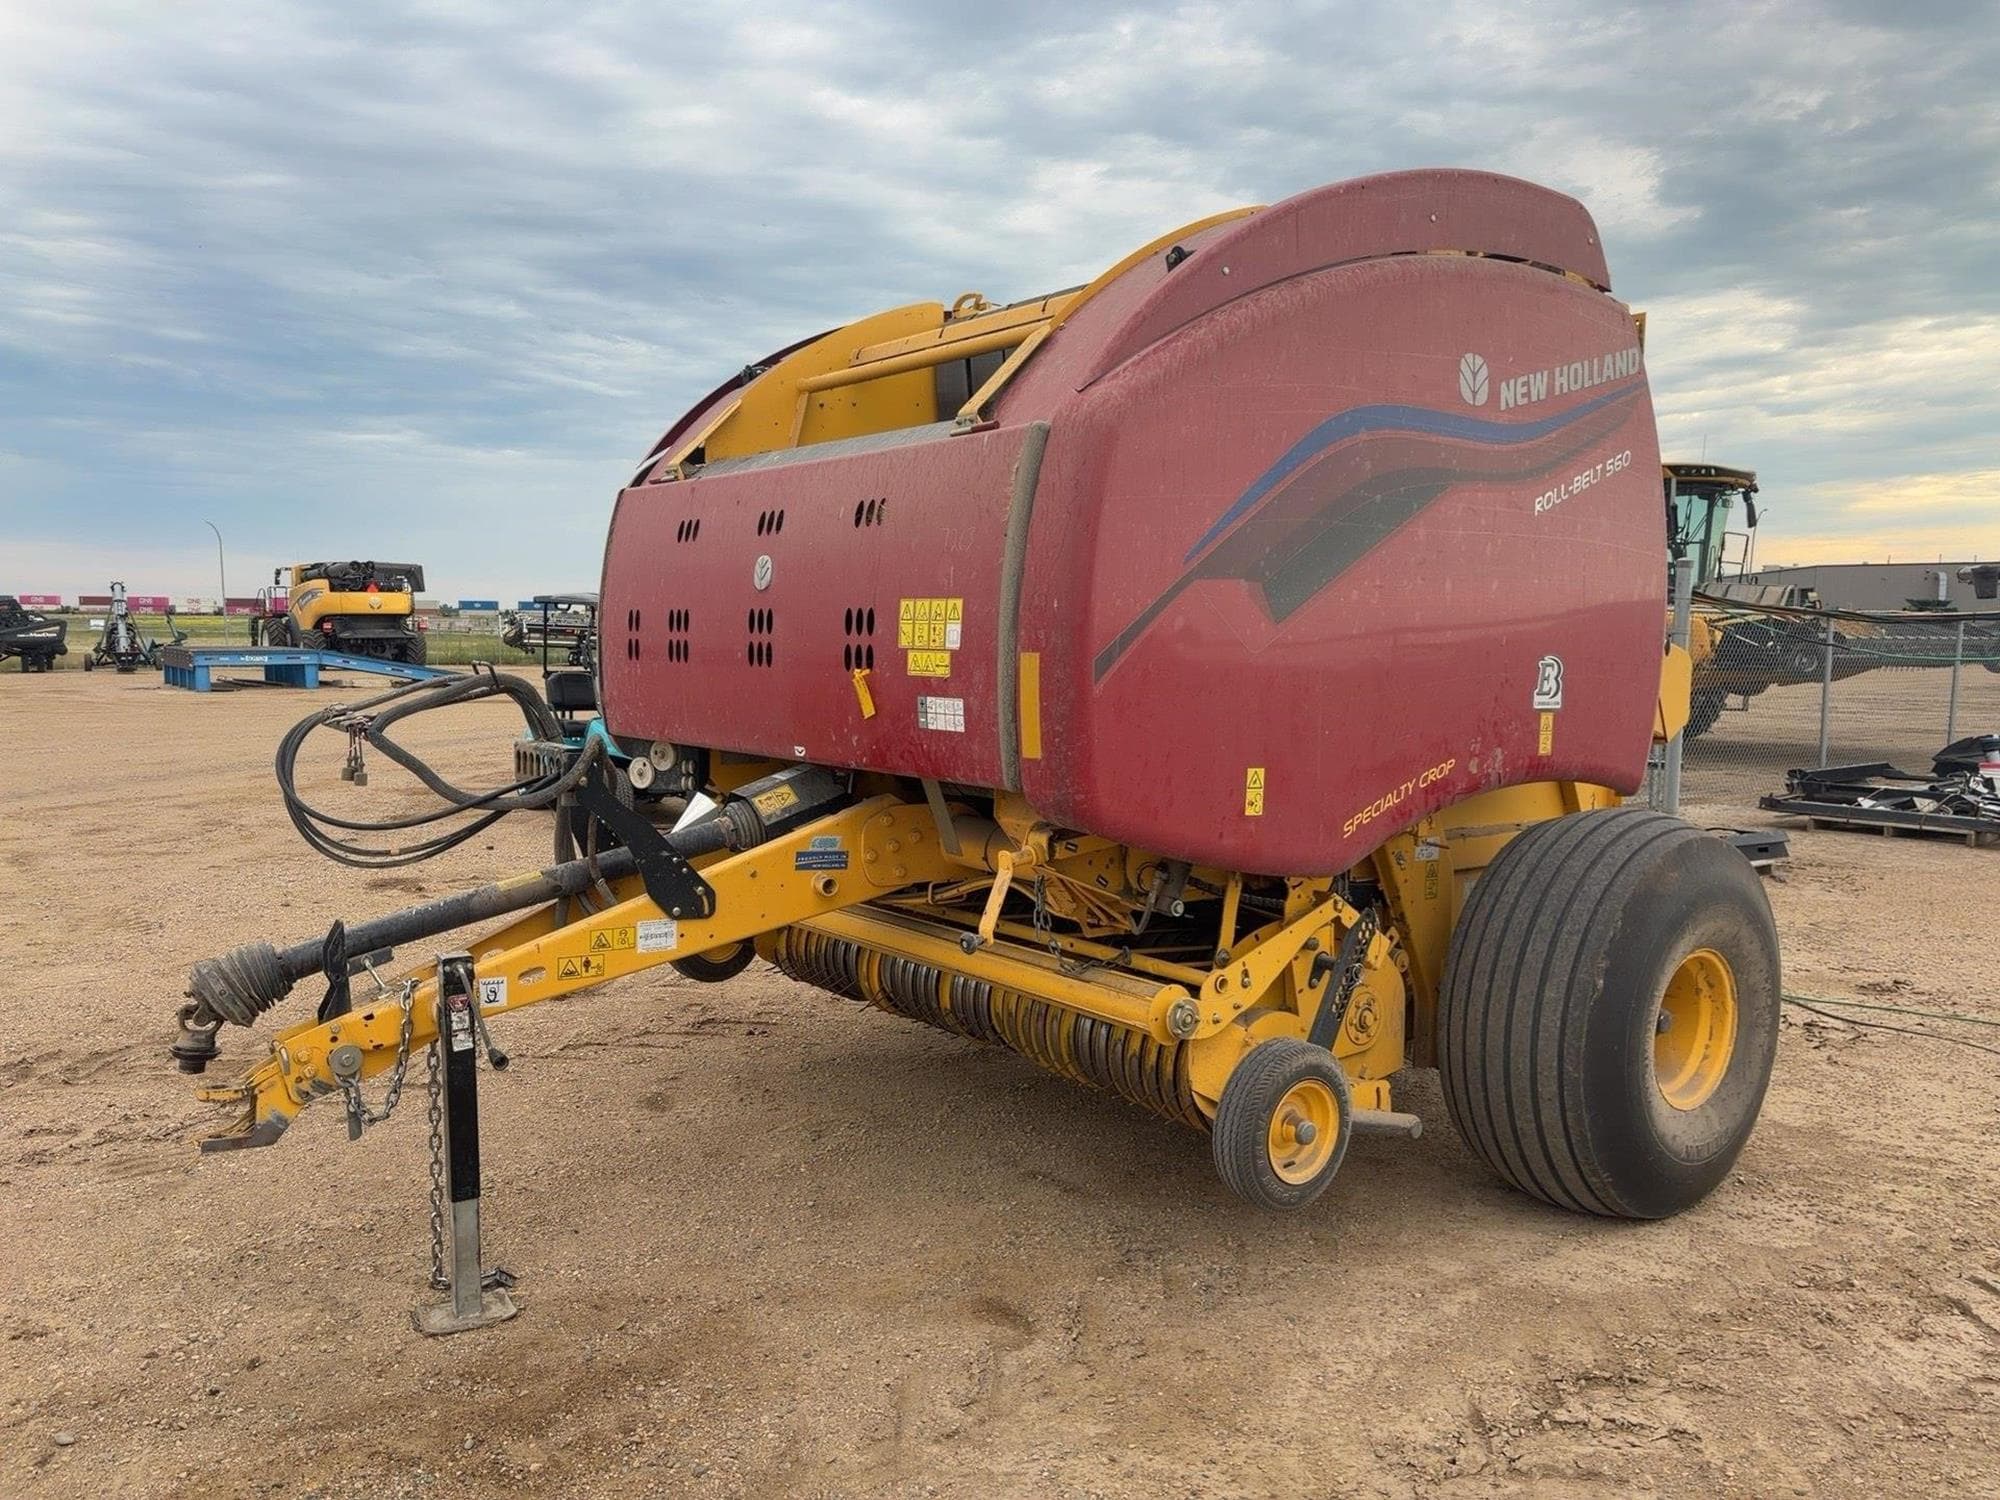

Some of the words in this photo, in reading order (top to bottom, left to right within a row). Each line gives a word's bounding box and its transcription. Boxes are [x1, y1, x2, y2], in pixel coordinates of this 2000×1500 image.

[1500, 370, 1549, 411] NEW
[1554, 348, 1640, 396] HOLLAND
[1534, 464, 1603, 516] ROLL-BELT
[1606, 450, 1631, 477] 560
[1343, 778, 1416, 838] SPECIALTY
[1419, 758, 1456, 789] CROP
